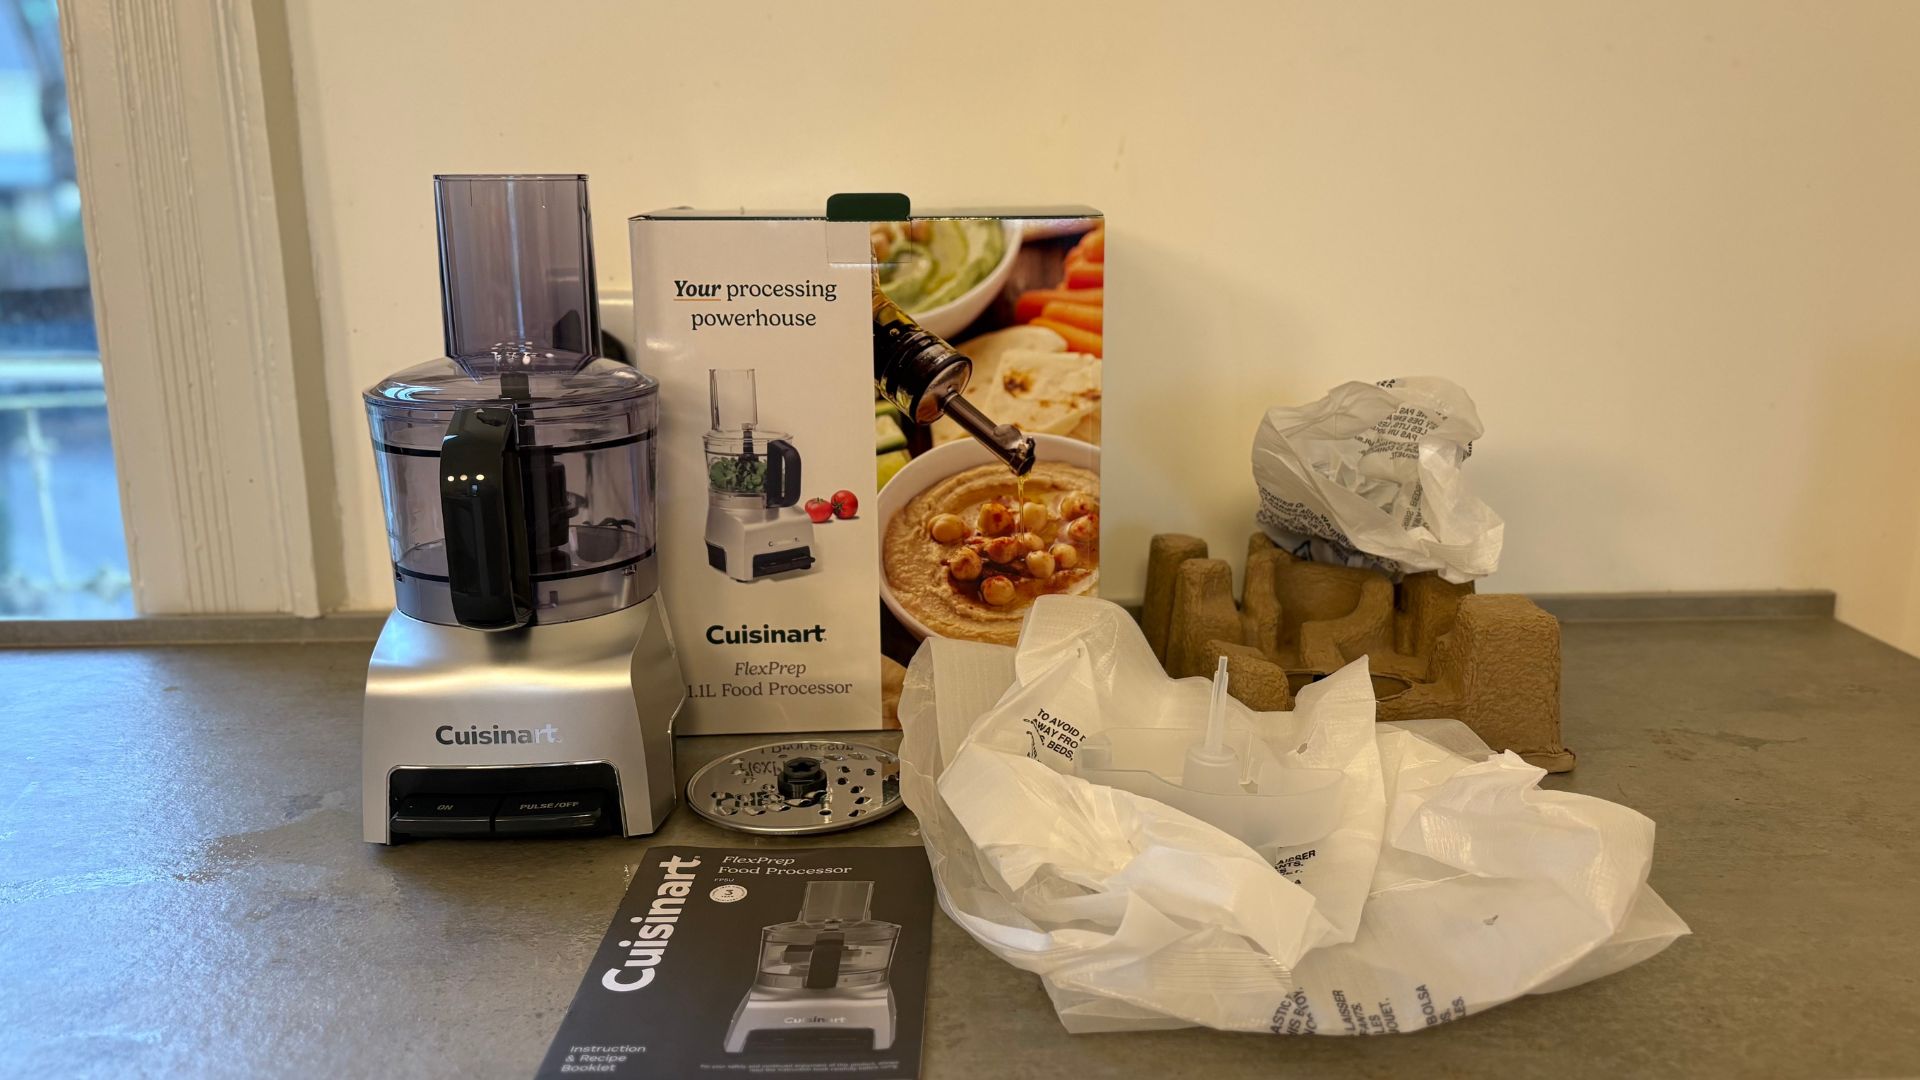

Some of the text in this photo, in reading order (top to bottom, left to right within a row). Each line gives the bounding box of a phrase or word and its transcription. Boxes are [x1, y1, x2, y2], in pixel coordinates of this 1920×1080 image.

[674, 280, 837, 301] Your processing
[691, 309, 817, 330] powerhouse
[705, 624, 826, 644] Cuisinart
[734, 661, 807, 677] FlexPrep
[687, 681, 853, 698] 1.1L Food Processor
[1037, 708, 1080, 737] TO AVOID
[435, 724, 560, 745] Cuisinart
[1046, 740, 1074, 761] BEDS,
[519, 801, 580, 811] PULSE/OFF
[722, 856, 796, 866] FlexPrep
[718, 866, 852, 875] Food Processor
[602, 855, 701, 992] Cuisinart
[1415, 984, 1438, 1026] BOLSA
[565, 1054, 627, 1063] & Recipe
[570, 1045, 646, 1054] Instruction
[561, 1064, 617, 1072] Booklet
